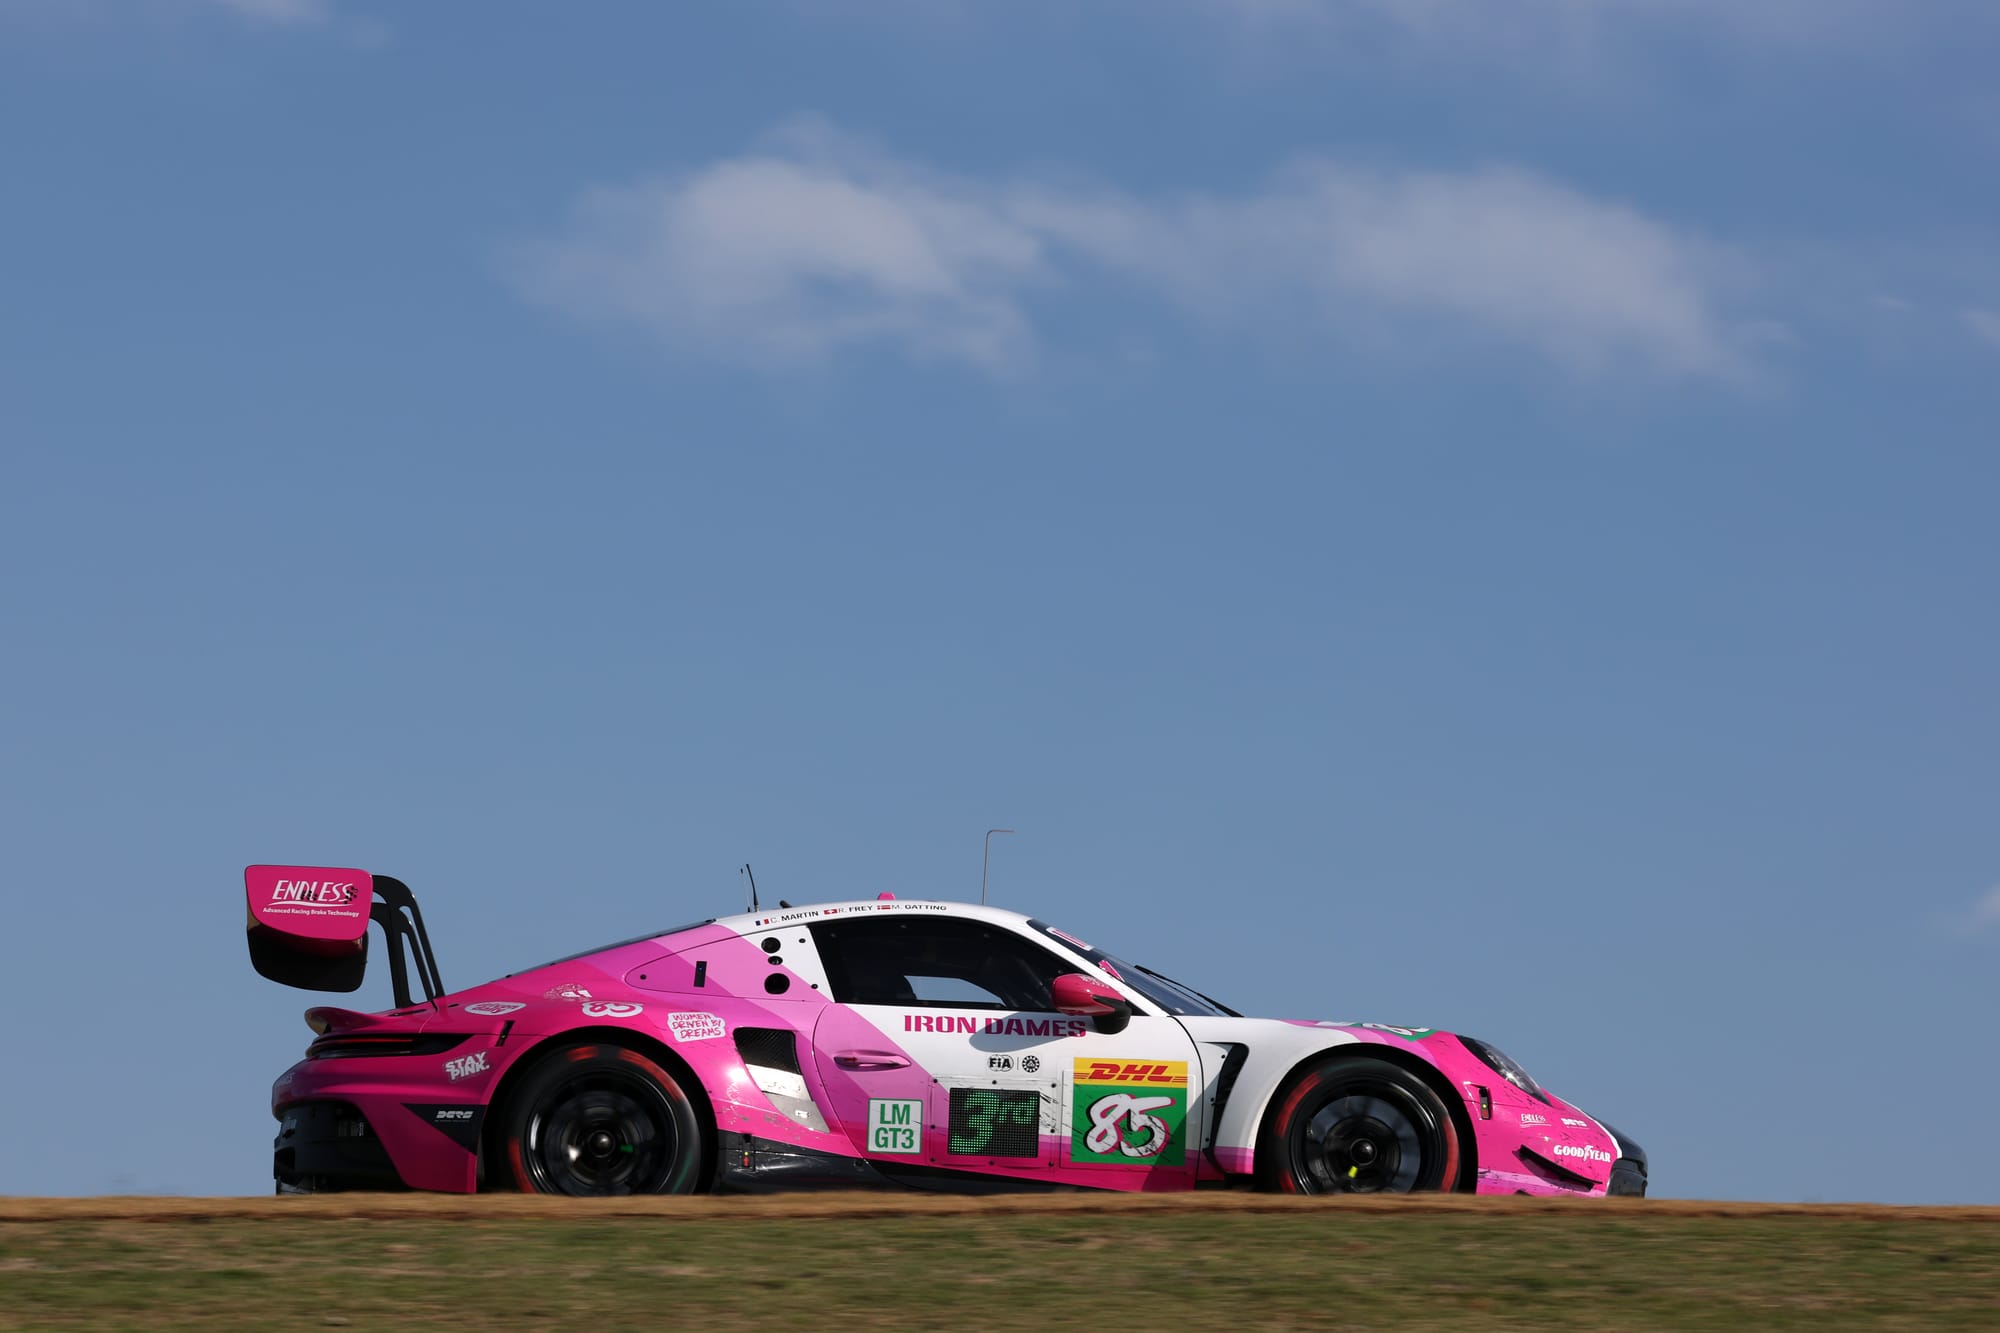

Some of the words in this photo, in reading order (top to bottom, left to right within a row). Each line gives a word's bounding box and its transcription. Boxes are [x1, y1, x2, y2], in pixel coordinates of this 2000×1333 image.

[272, 879, 354, 902] ENDLESS
[781, 910, 819, 922] MARTIN
[672, 1013, 711, 1021] WOMEN
[672, 1020, 709, 1029] DRIVEN
[711, 1019, 721, 1027] BY
[904, 1015, 976, 1034] IRON
[984, 1017, 1087, 1038] DAMES
[680, 1027, 722, 1038] DREAMS
[445, 1051, 487, 1072] STAY
[451, 1062, 490, 1080] PINK.
[1088, 1063, 1173, 1083] DHL
[880, 1104, 911, 1126] LM
[949, 1092, 1038, 1155] 3rd
[1083, 1093, 1176, 1158] 85
[874, 1128, 914, 1149] GT3
[1553, 1144, 1611, 1162] GOODYEAR
